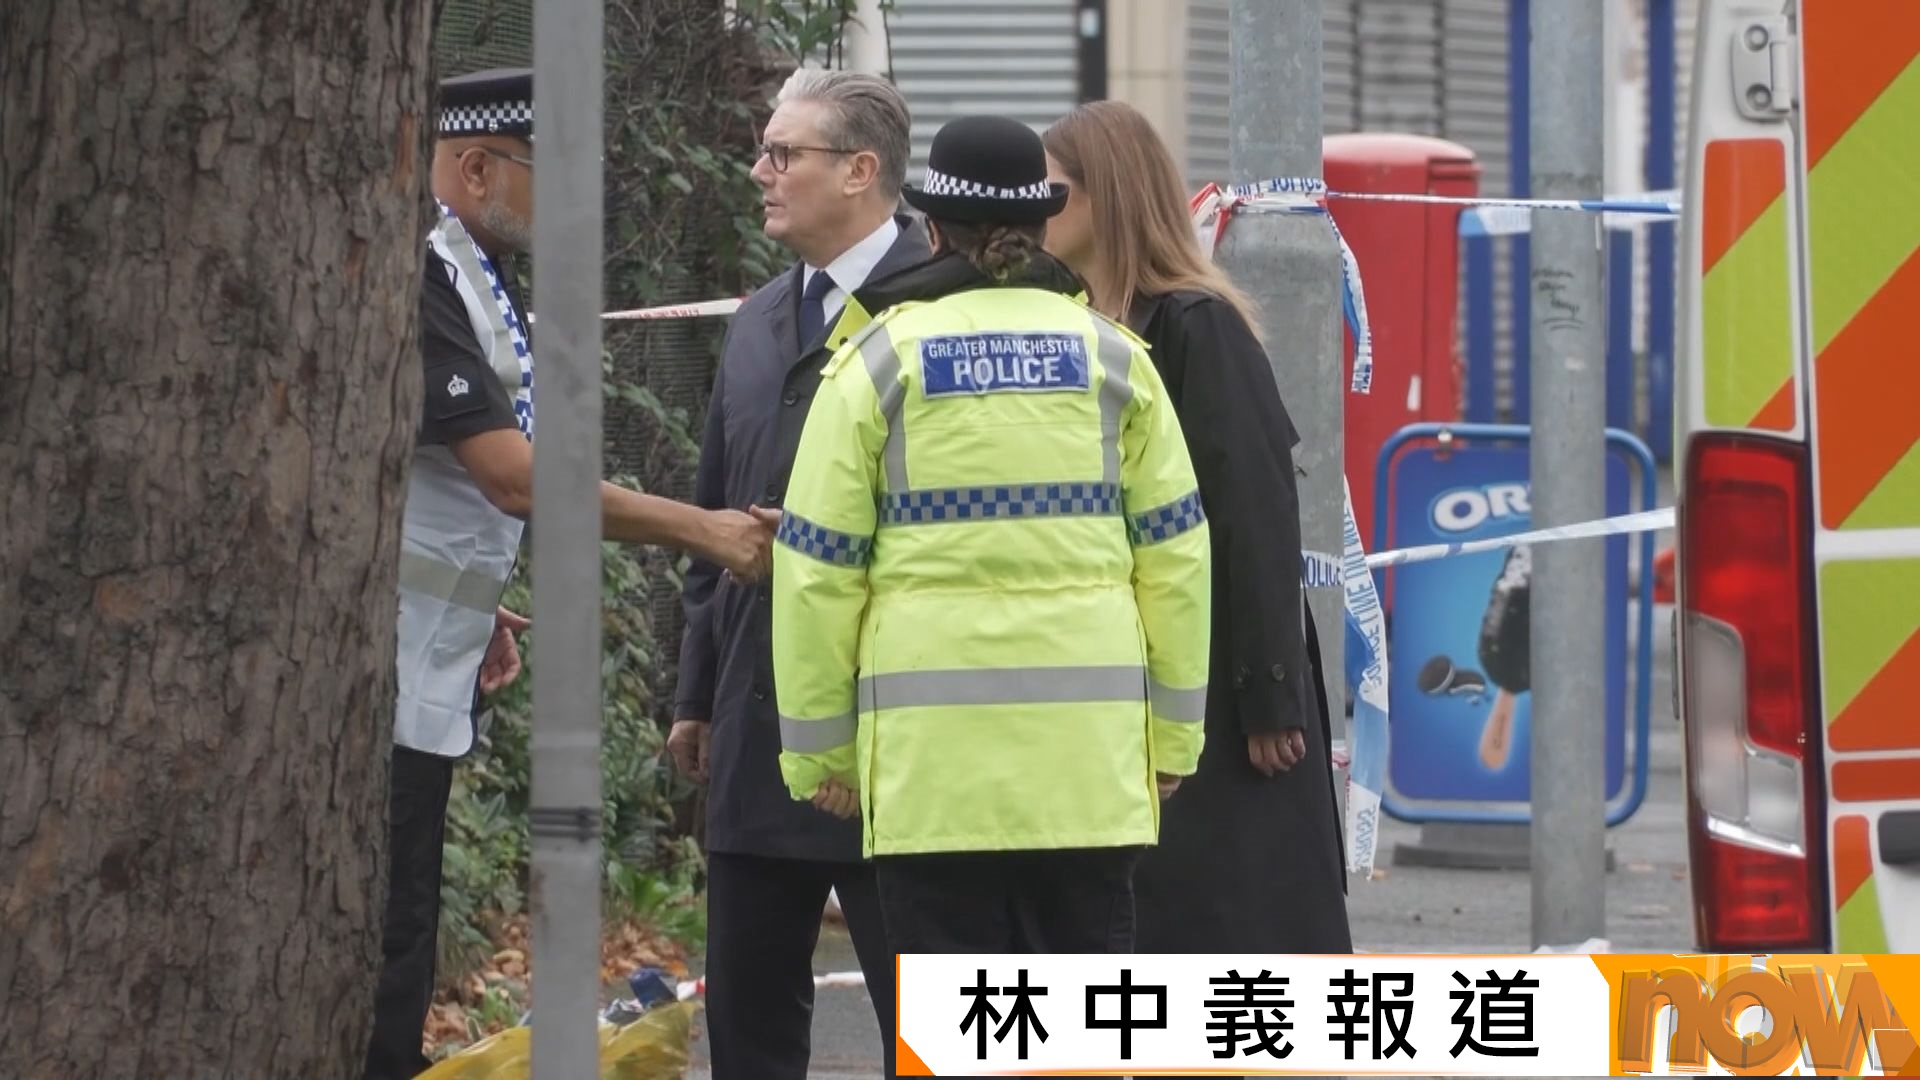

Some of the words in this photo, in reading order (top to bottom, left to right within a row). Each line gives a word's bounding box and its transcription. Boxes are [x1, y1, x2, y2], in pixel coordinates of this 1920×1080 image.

[928, 340, 987, 359] GREATER
[989, 338, 1080, 356] MANCHESTER
[952, 356, 1062, 386] POLICE
[1434, 485, 1532, 531] OR
